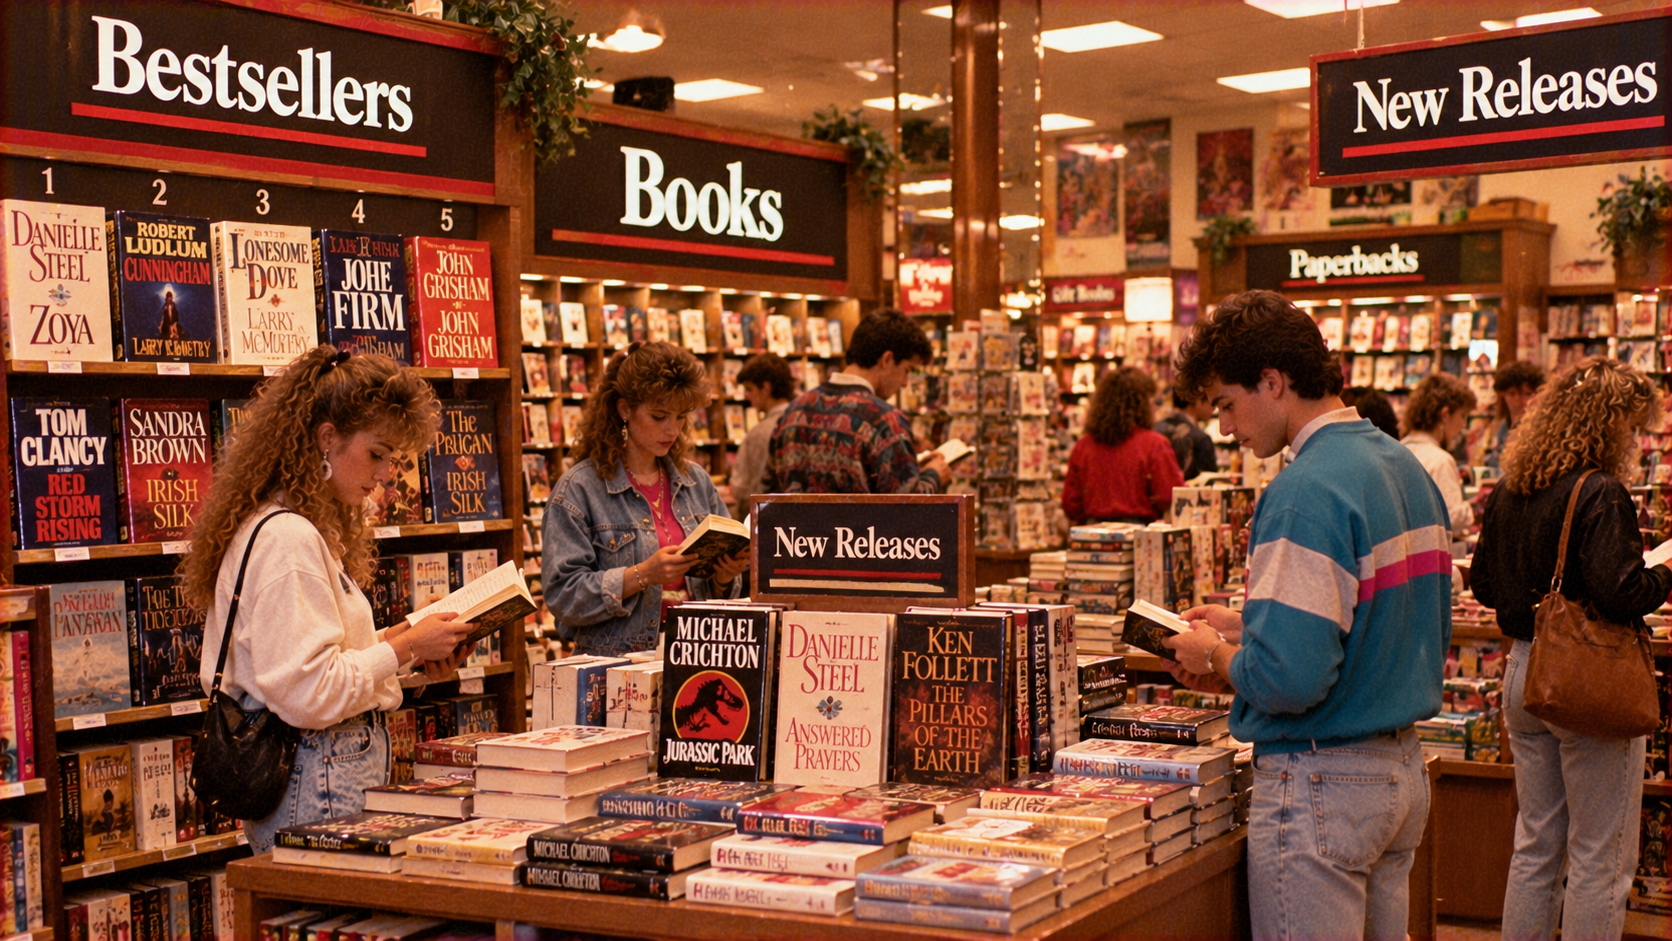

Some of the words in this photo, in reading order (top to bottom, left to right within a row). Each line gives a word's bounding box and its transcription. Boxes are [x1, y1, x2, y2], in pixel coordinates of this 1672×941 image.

[91, 16, 413, 132] Bestsellers
[1352, 78, 1449, 133] New
[1458, 57, 1658, 123] Releases
[42, 167, 54, 195] 1
[152, 178, 167, 205] 2
[620, 146, 784, 242] Books
[256, 189, 270, 215] 3
[351, 199, 365, 223] 4
[11, 210, 102, 251] DANIELLE
[137, 222, 196, 241] ROBERT
[441, 208, 453, 231] 5
[125, 237, 207, 259] LUDLUM
[229, 232, 309, 270] LONESOME
[29, 243, 90, 283] STEEL
[123, 256, 211, 285] CUNNINGHAM
[341, 258, 392, 293] JOHE
[436, 250, 474, 275] JOHN
[1289, 243, 1419, 283] Paperbacks
[246, 263, 298, 300] DOVE
[423, 272, 490, 301] GRISHAM
[247, 307, 294, 332] LARRY
[332, 290, 406, 331] FIRM
[438, 310, 479, 335] JOHN
[30, 305, 95, 345] ZOYA
[428, 333, 493, 359] GRISHAM
[35, 408, 87, 436] TOM
[129, 408, 207, 438] SANDRA
[20, 436, 107, 466] CLANCY
[131, 437, 207, 465] BROWN
[48, 473, 86, 496] RED
[146, 479, 199, 503] IRISH
[447, 470, 487, 492] IRISH
[35, 494, 101, 519] STORM
[154, 503, 196, 530] SILK
[450, 492, 486, 515] SILK
[36, 517, 102, 542] RISING
[773, 526, 829, 558] New
[834, 525, 941, 560] Releases
[676, 616, 757, 643] MICHAEL
[786, 624, 879, 661] DANIELLE
[927, 626, 974, 655] KEN
[669, 641, 760, 669] CRICHTON
[902, 650, 997, 683] FOLLETT
[801, 654, 865, 694] STEEL
[932, 685, 965, 704] THE
[908, 698, 988, 727] PILLARS
[785, 717, 872, 748] ANSWERED
[914, 725, 940, 746] OF
[943, 727, 982, 750] THE
[663, 738, 720, 764] JURASSIC
[721, 741, 756, 766] PARK
[793, 743, 861, 773] PRAYERS
[913, 748, 981, 774] EARTH
